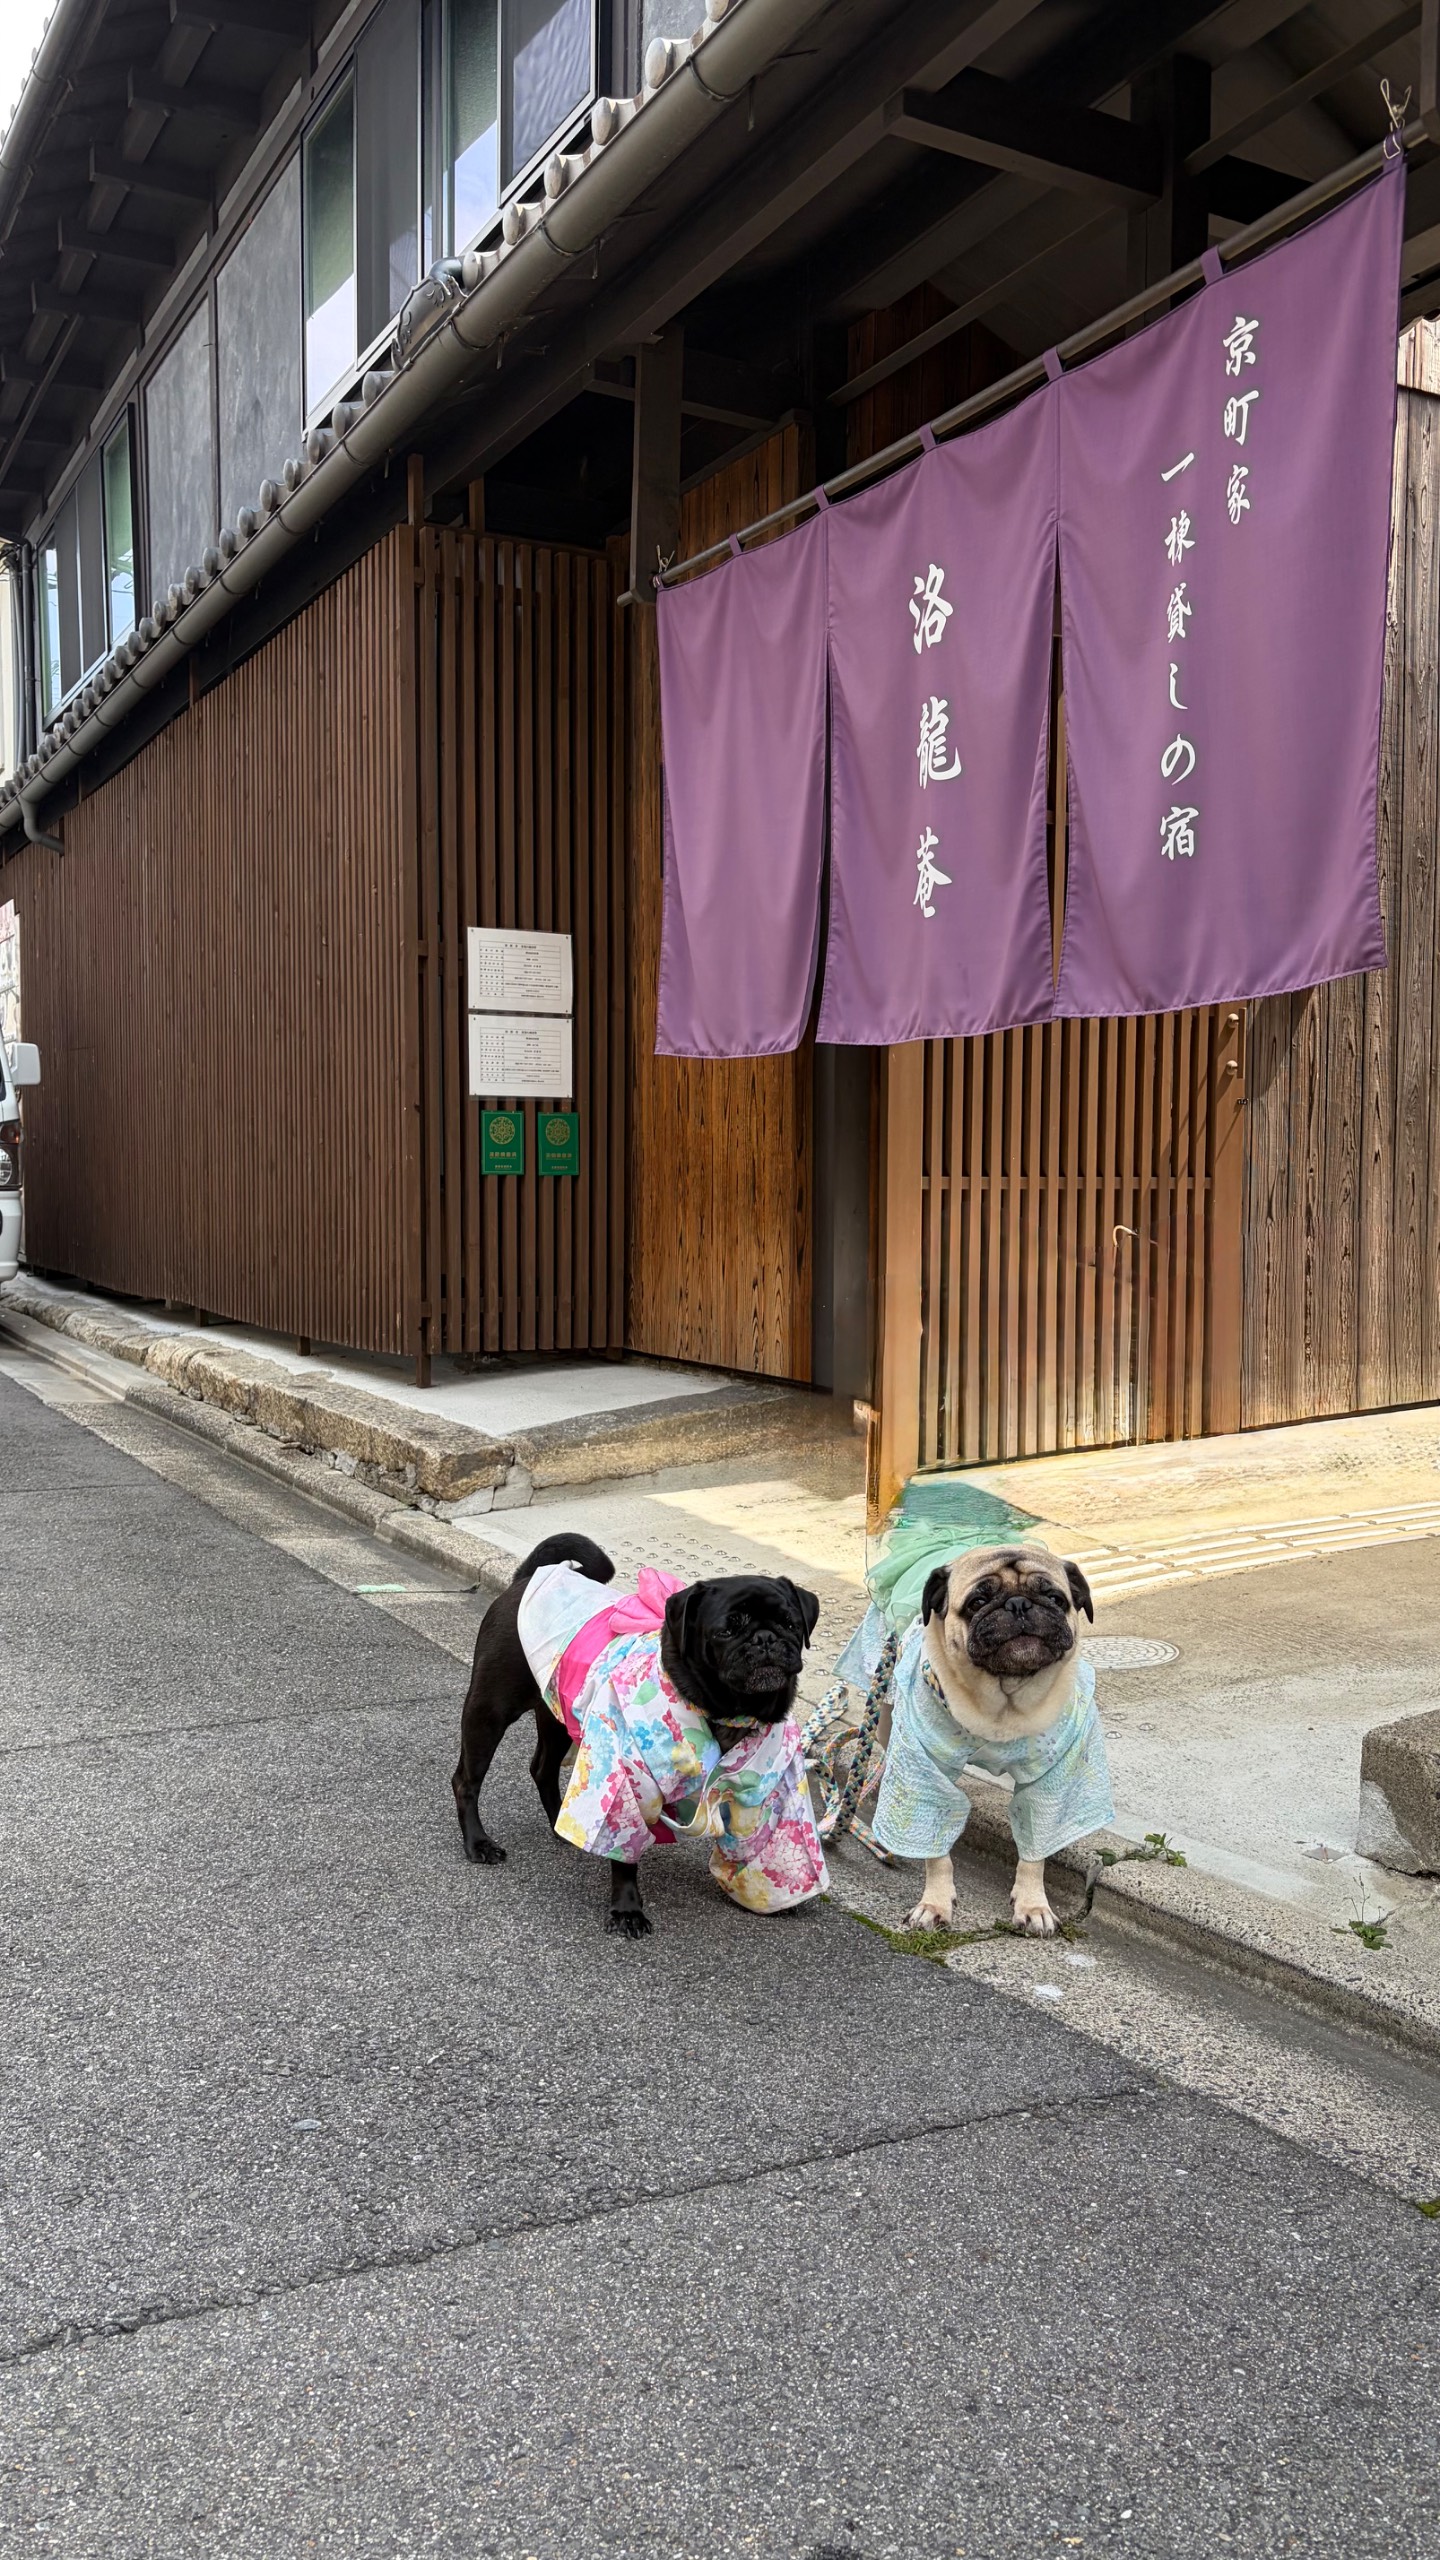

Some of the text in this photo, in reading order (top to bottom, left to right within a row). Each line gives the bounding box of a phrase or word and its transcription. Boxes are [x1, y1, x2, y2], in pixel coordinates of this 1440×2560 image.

[1223, 317, 1260, 525] 京町家
[1160, 453, 1199, 861] 一棟貸しの宿
